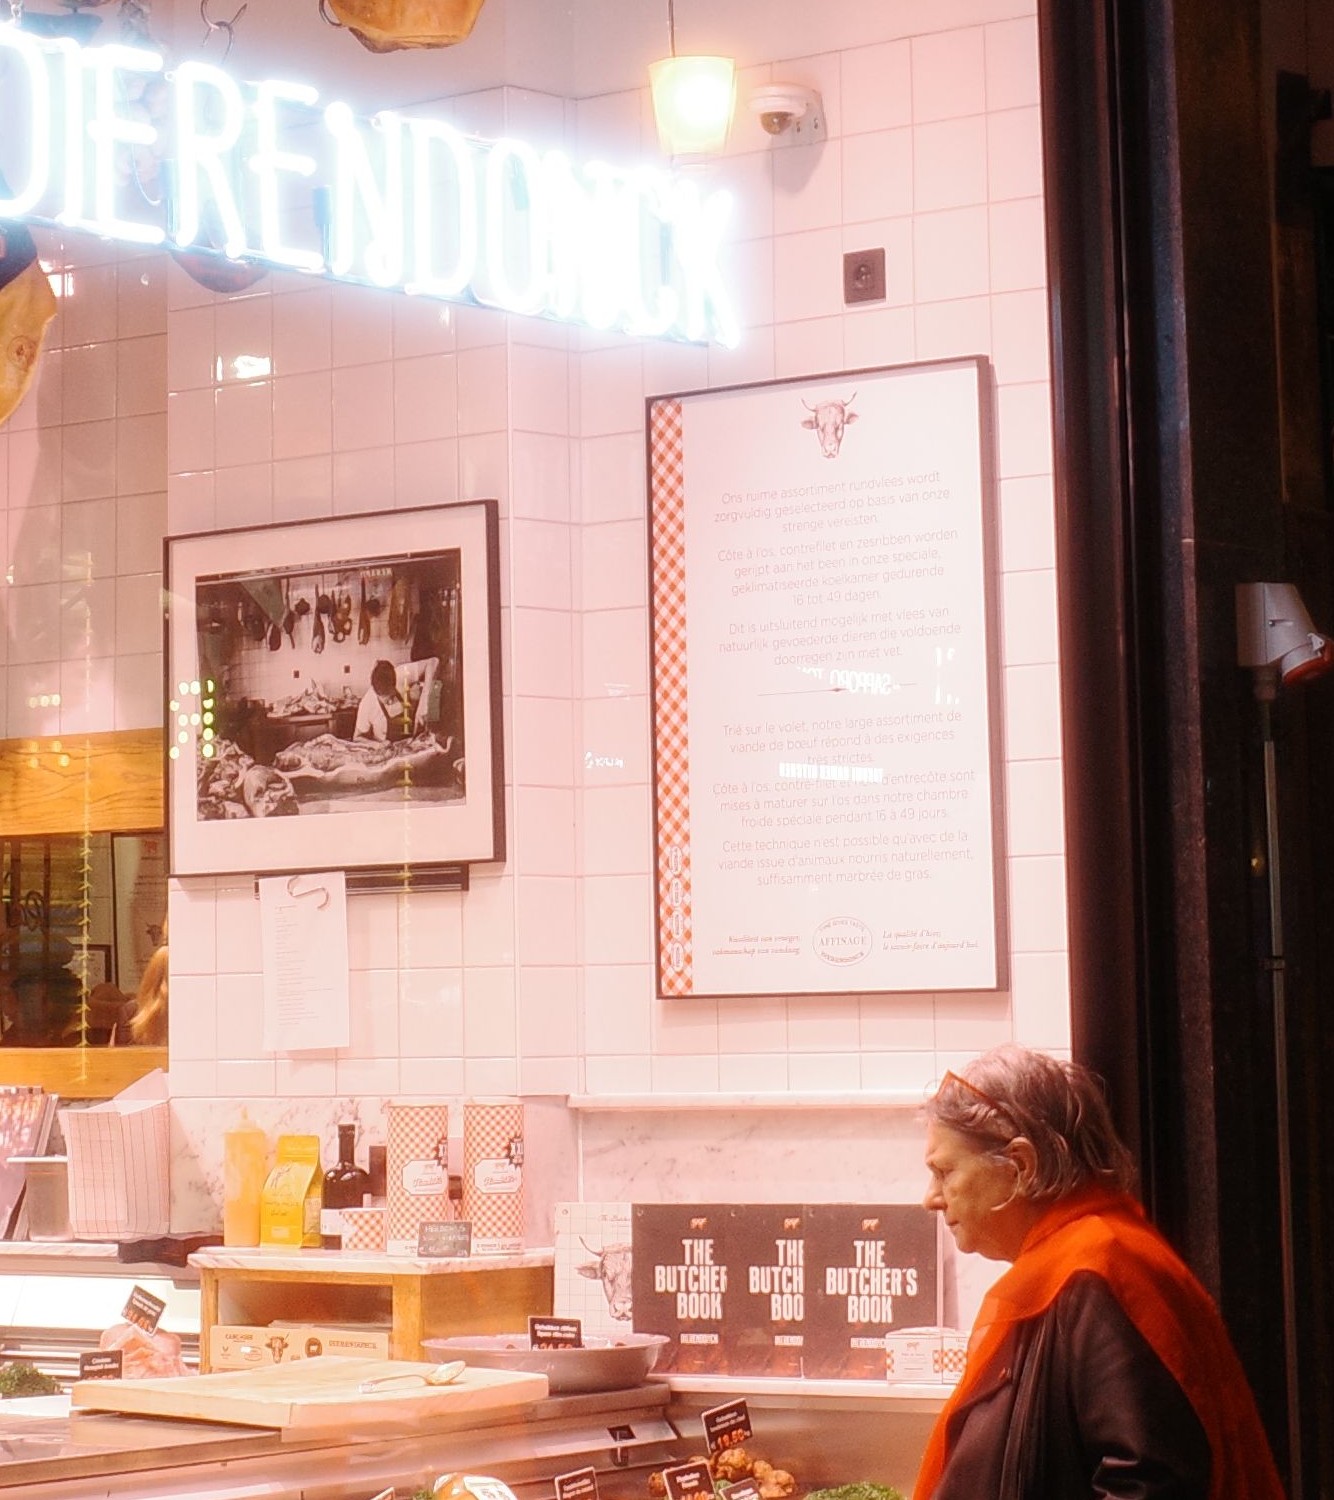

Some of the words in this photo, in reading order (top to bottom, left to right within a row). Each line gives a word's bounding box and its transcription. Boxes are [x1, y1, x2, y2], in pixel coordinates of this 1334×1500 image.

[819, 935, 867, 946] AFFINAGE
[682, 1238, 714, 1266] THE
[853, 1240, 886, 1268] THE
[825, 1267, 918, 1297] BUTCHER'S
[676, 1293, 722, 1320] BOOK
[847, 1295, 894, 1324] BOOK
